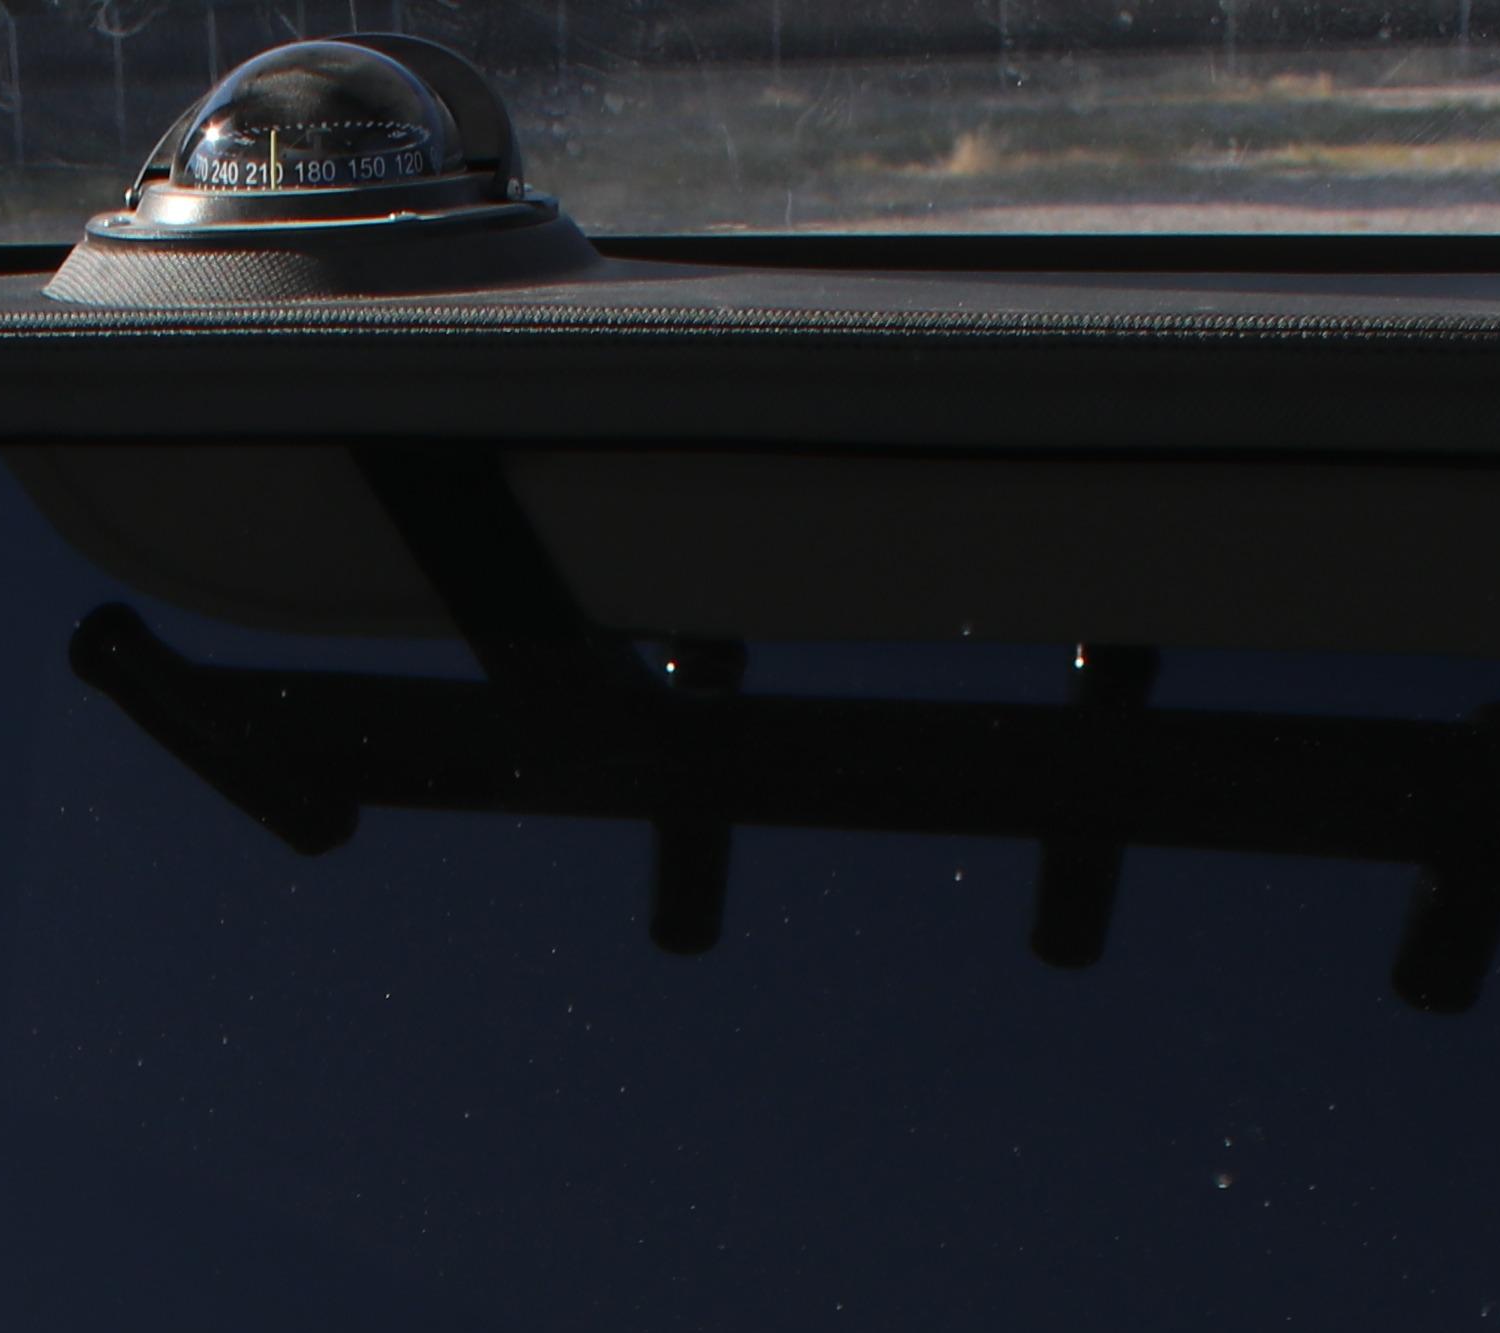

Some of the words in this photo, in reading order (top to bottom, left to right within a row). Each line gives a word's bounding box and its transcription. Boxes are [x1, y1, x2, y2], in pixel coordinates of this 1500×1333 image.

[211, 159, 238, 185] 240
[295, 159, 336, 183] 180
[349, 156, 386, 179] 150
[395, 150, 423, 174] 120
